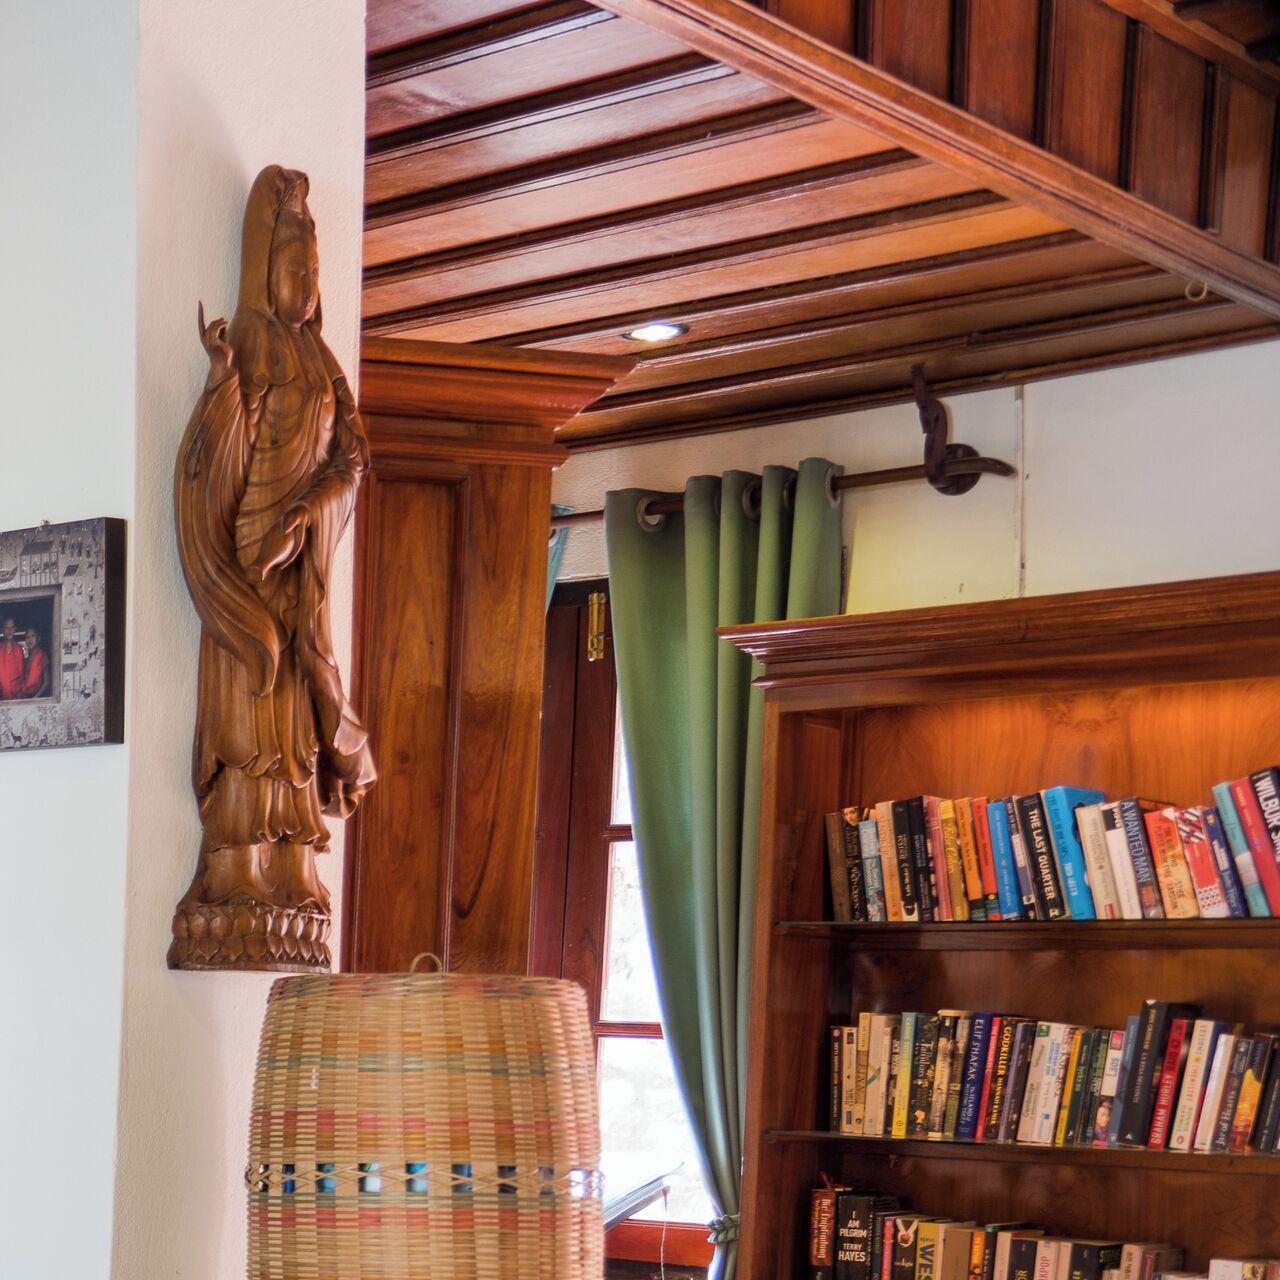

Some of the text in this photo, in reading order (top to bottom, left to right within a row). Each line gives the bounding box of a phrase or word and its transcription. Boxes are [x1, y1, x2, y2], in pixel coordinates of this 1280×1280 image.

[1122, 800, 1134, 809] A
[1255, 776, 1280, 828] WILBUR
[1123, 810, 1144, 856] WANTED
[1028, 808, 1056, 900] THE LAST QUARTER
[1134, 857, 1151, 883] MAN
[967, 1019, 984, 1081] ELIF SHAFAK
[997, 1026, 1012, 1076] GODKILLER
[1106, 1057, 1119, 1077] Laos
[1159, 1074, 1174, 1105] HURLEY
[1152, 1109, 1167, 1144] GRAHAM
[1215, 1130, 1225, 1146] Jar
[1222, 1091, 1236, 1120] Hearts
[839, 1228, 867, 1239] PILGRIM
[847, 1220, 860, 1228] AM
[838, 1251, 866, 1262] HAYES
[843, 1243, 862, 1251] TERRY
